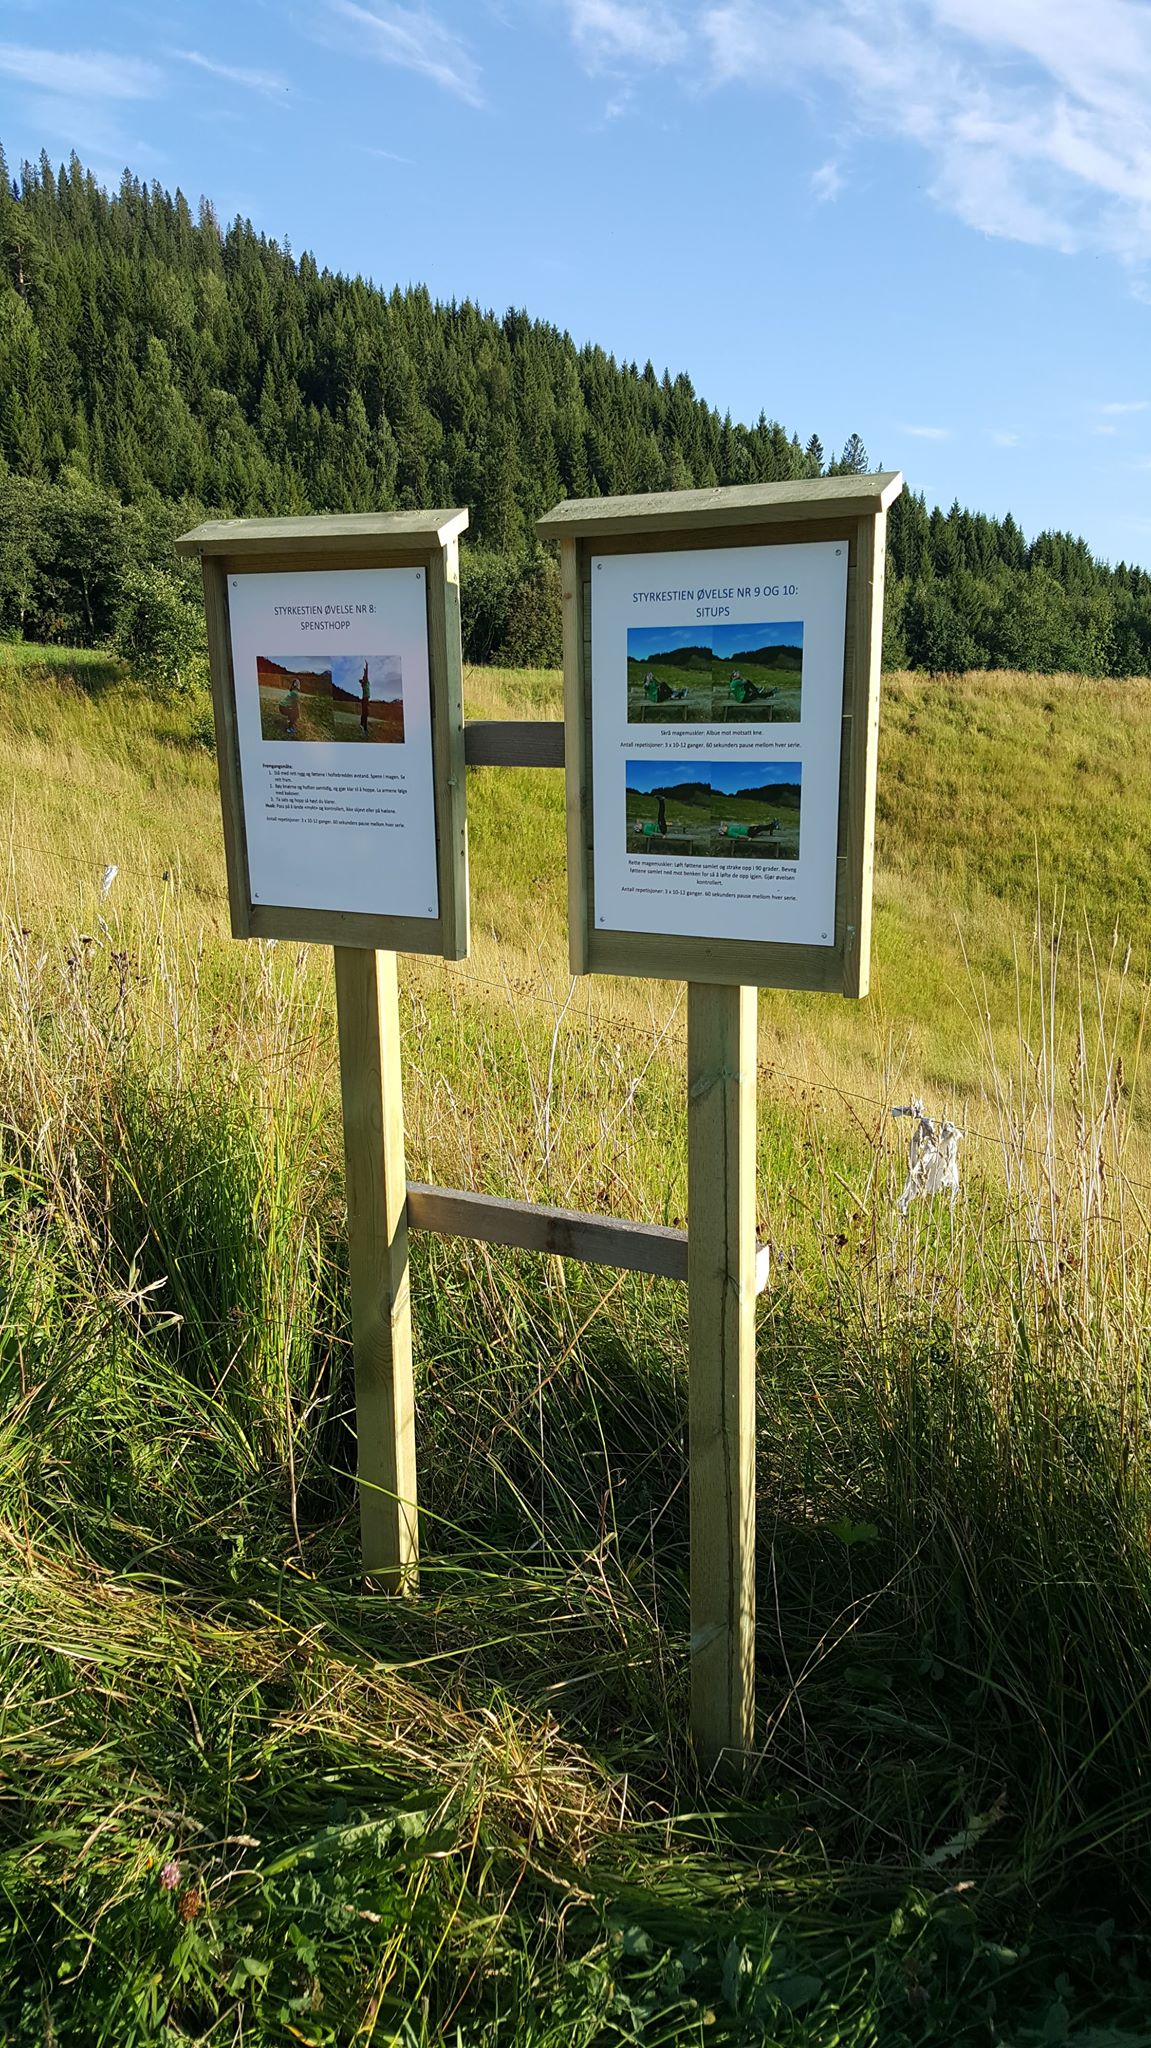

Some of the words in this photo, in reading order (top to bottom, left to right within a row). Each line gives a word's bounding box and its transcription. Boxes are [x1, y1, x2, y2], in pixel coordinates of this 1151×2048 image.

[633, 590, 694, 602] STYRKESTIEN
[697, 588, 734, 600] ØVELSE
[737, 588, 750, 598] NR
[754, 587, 760, 597] 9
[764, 586, 779, 596] OG
[782, 585, 798, 595] 10:
[274, 606, 322, 615] STYRKESTIEN
[325, 604, 353, 615] ØVELSE
[356, 604, 367, 613] NR
[368, 604, 376, 613] 8:
[696, 607, 730, 617] SITUPS
[300, 621, 350, 630] SPENSTHOPP
